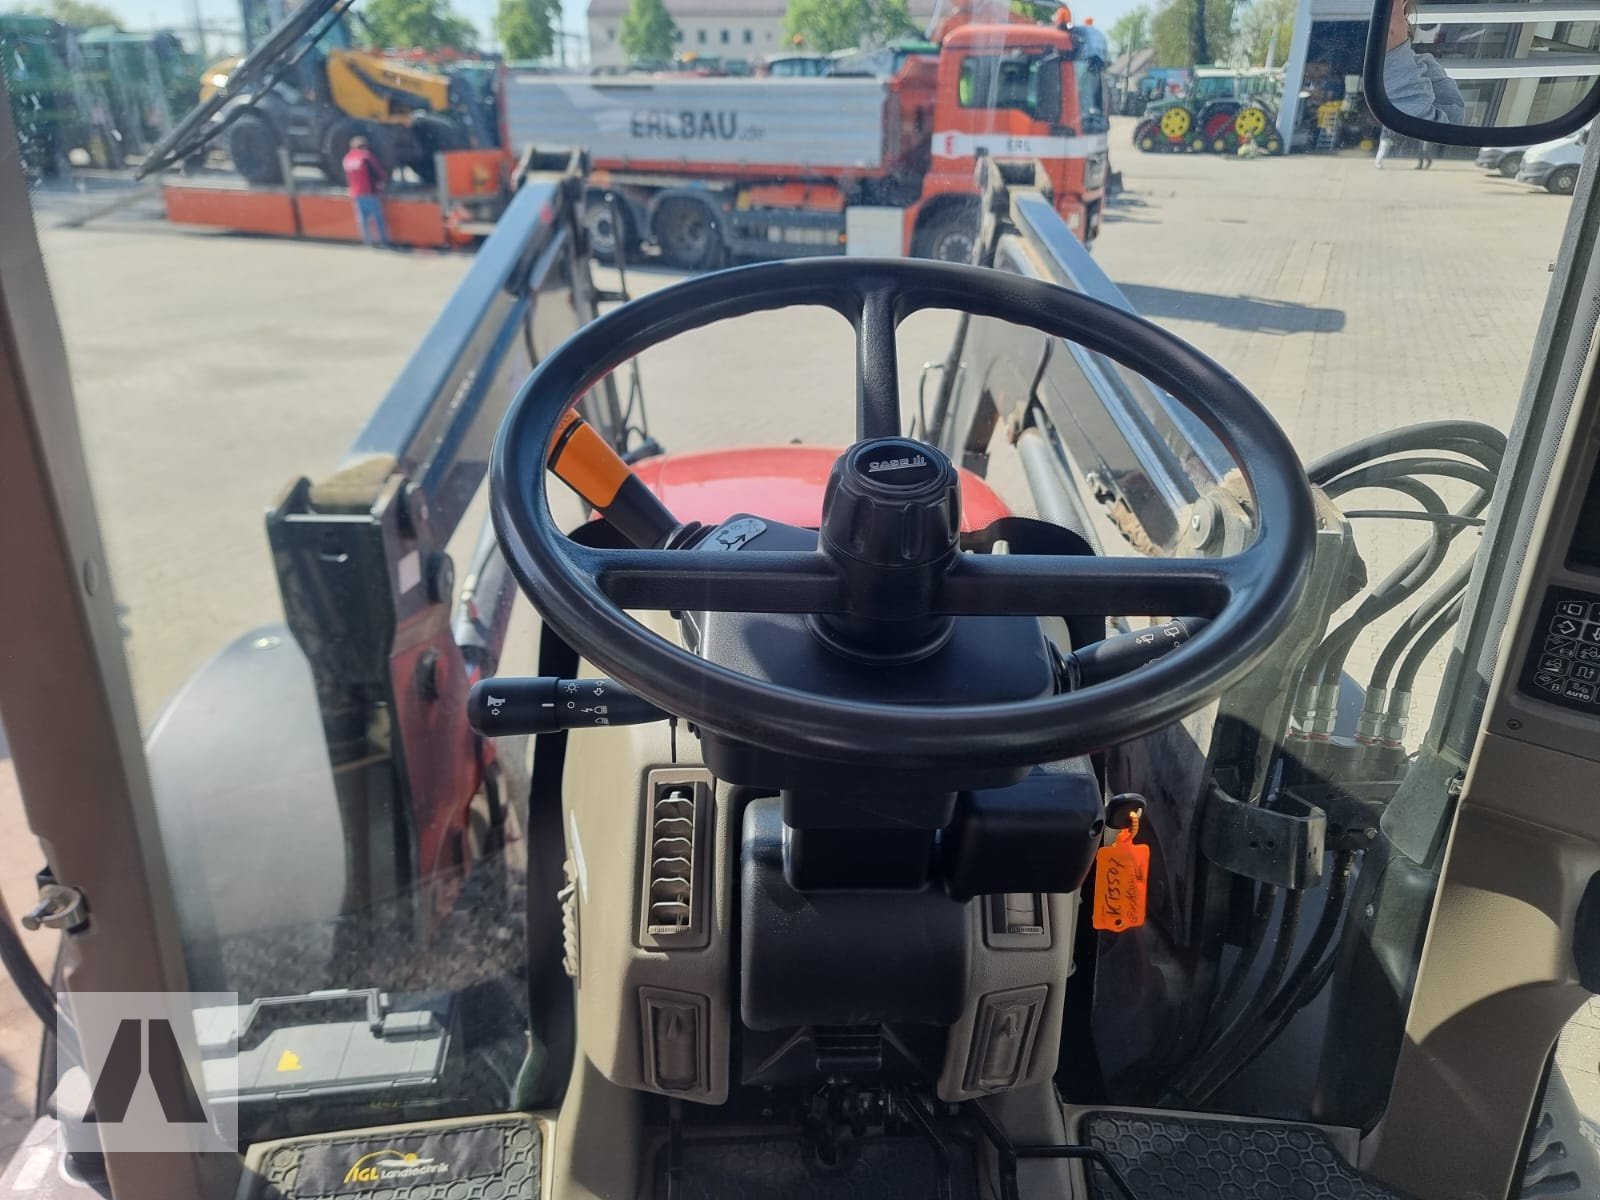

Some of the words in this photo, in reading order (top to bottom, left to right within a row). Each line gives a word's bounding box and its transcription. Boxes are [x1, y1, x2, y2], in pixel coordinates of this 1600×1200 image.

[869, 457, 909, 470] CASE
[1565, 689, 1591, 700] AUTO
[380, 1161, 450, 1180] Landtechnik
